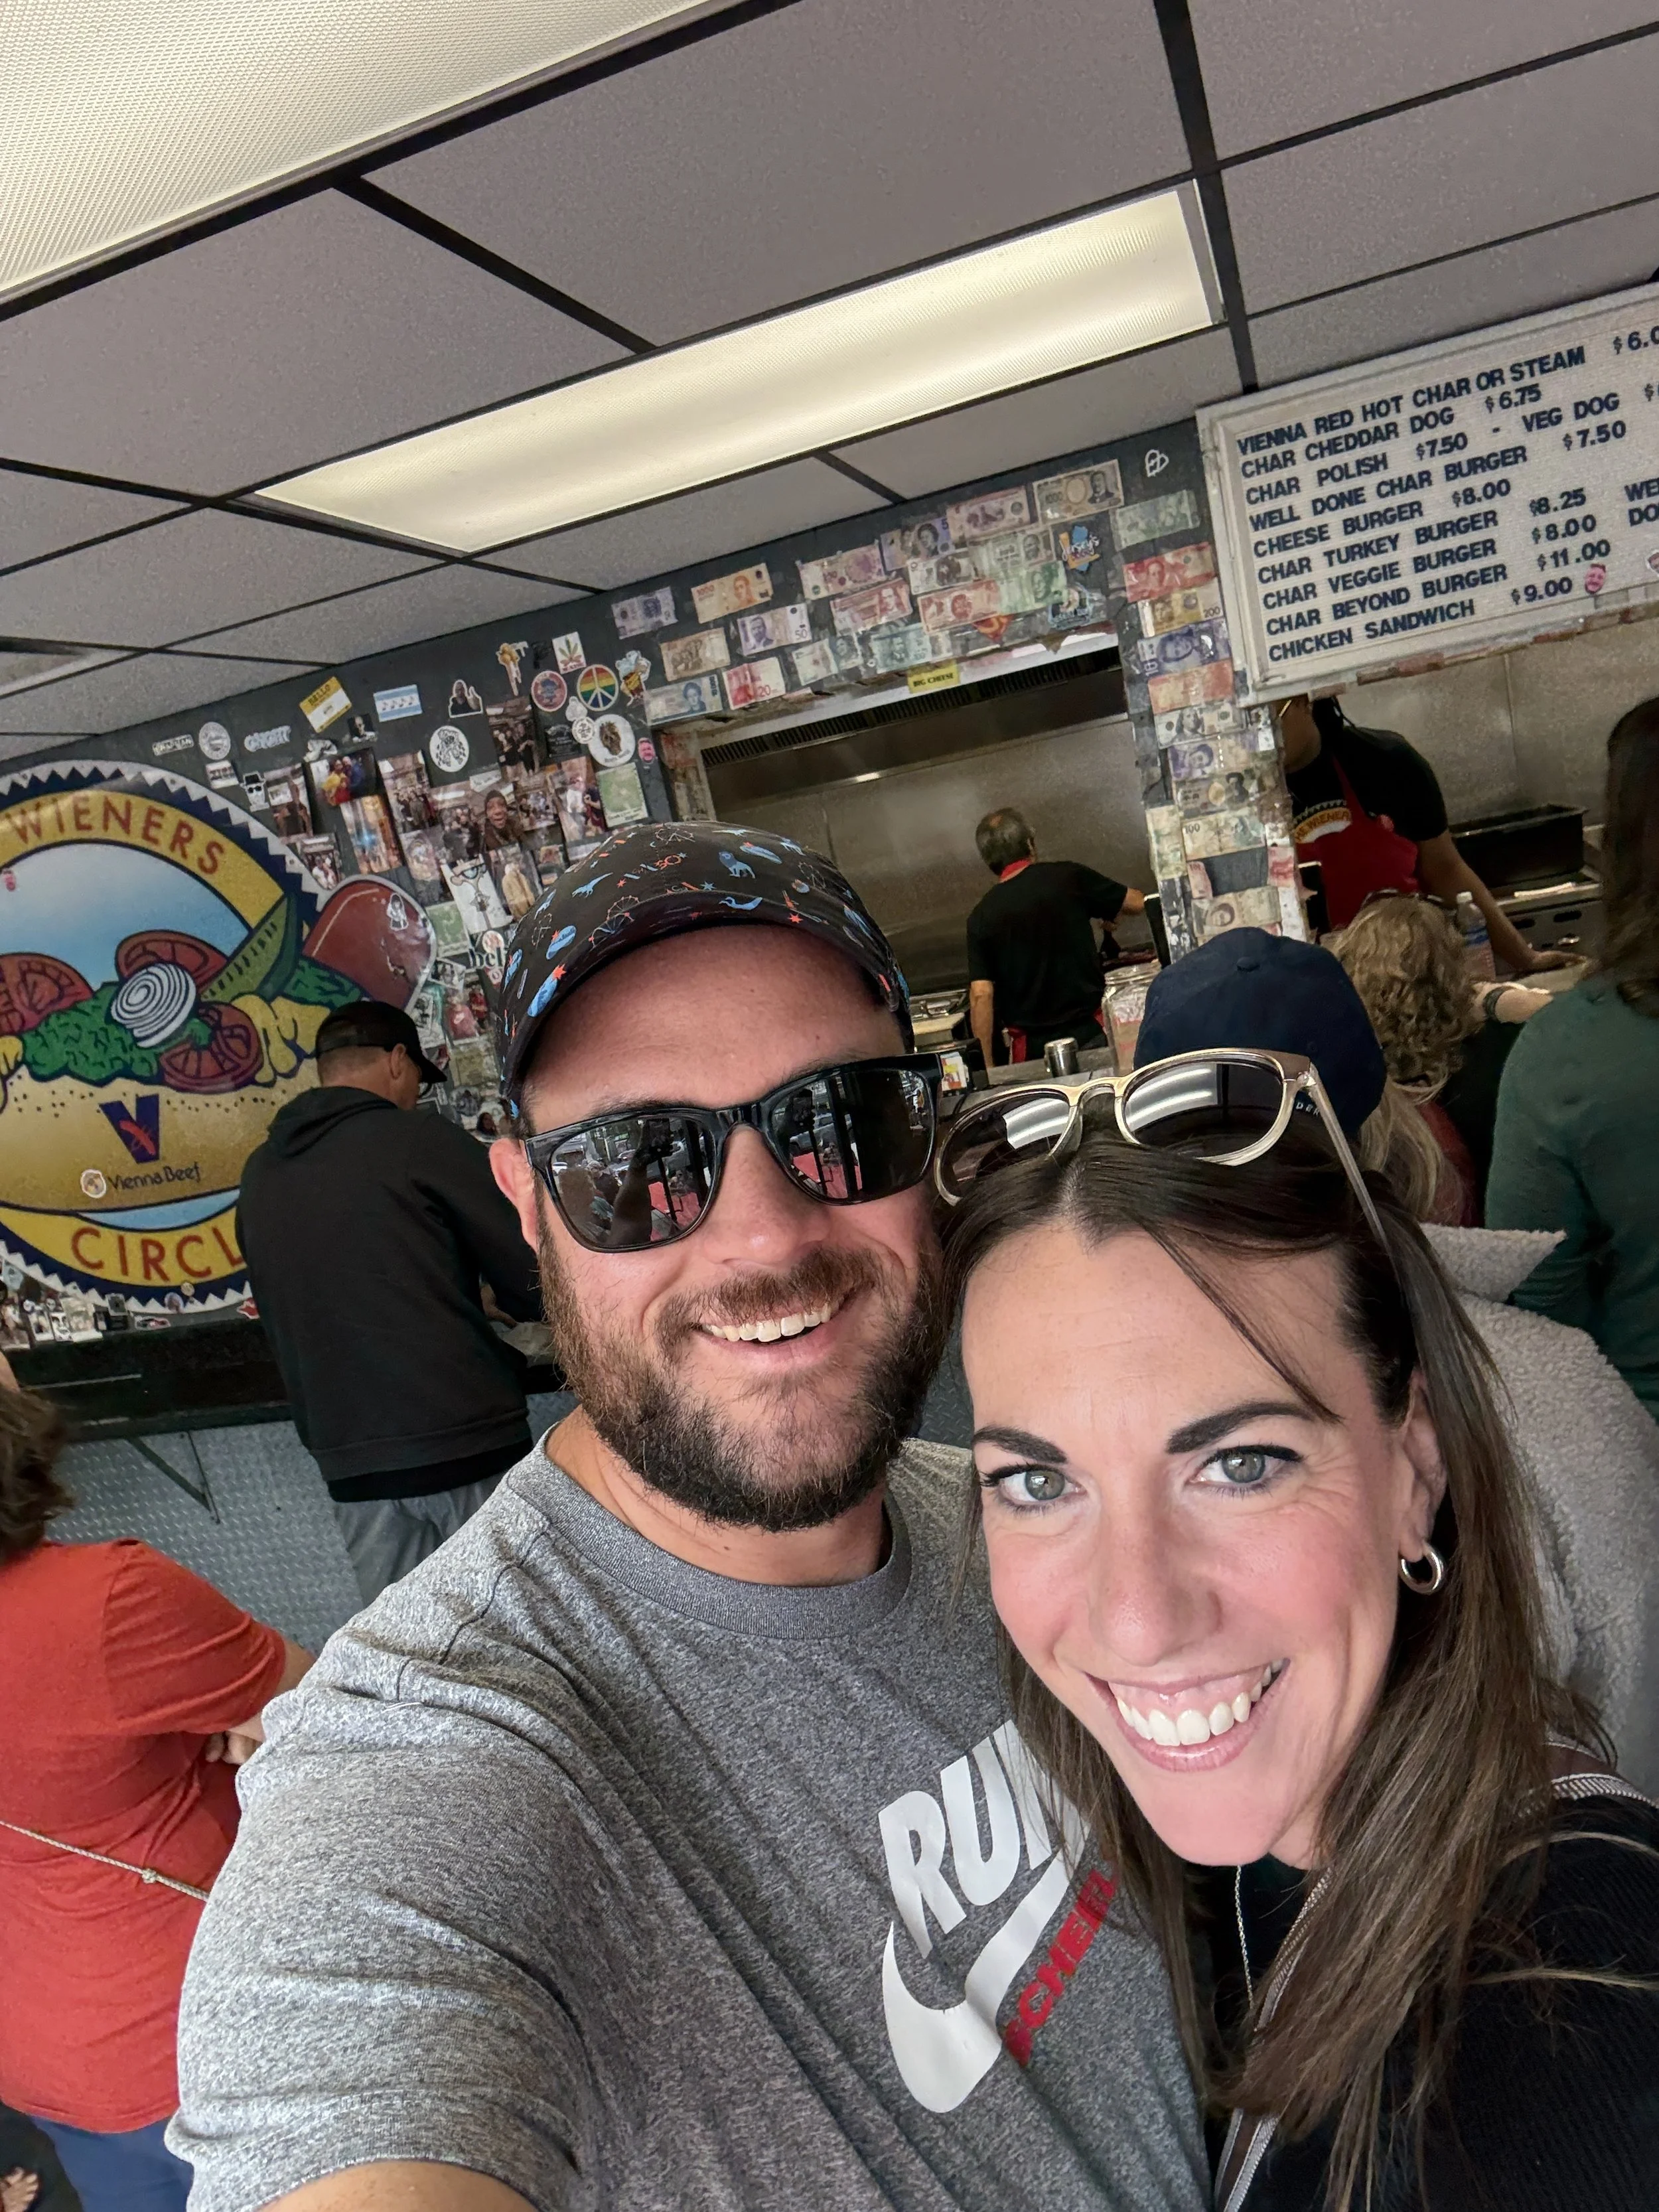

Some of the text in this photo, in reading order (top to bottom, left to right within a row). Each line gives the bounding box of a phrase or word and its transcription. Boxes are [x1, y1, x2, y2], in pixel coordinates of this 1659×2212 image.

[1238, 422, 1307, 456] VIENNA
[1314, 409, 1354, 435] RED
[1362, 395, 1404, 423] HOT
[1413, 378, 1471, 407] CHAR
[1476, 368, 1505, 392] OR
[1510, 346, 1585, 382] STEAM
[1242, 384, 1542, 479] CHAR CHEDDAR DOG $6.75
[1246, 477, 1301, 505] CHAR
[1317, 453, 1388, 487] POLISH
[1522, 407, 1563, 433] VEG
[1573, 392, 1620, 420] DOG
[1249, 420, 1626, 532] WELL DONE CHAR BURGER $7.50
[1624, 476, 1659, 502] WE
[1254, 479, 1511, 558] CHEESE BURGER $8.00
[1258, 487, 1587, 584] CHAR TURKEY BURGER $8.25
[1263, 514, 1597, 610] CHAR VEGGIE BURGER $8.00
[1266, 539, 1611, 635] CHAR BEYOND BURGER $11.00
[796, 629, 808, 640] 50
[1204, 607, 1220, 618] 200
[1269, 577, 1573, 662] CHICKEN SANDWICH $9.00
[758, 684, 771, 698] 20
[5, 795, 224, 875] WIENERS
[108, 1161, 202, 1190] Vienna Beef
